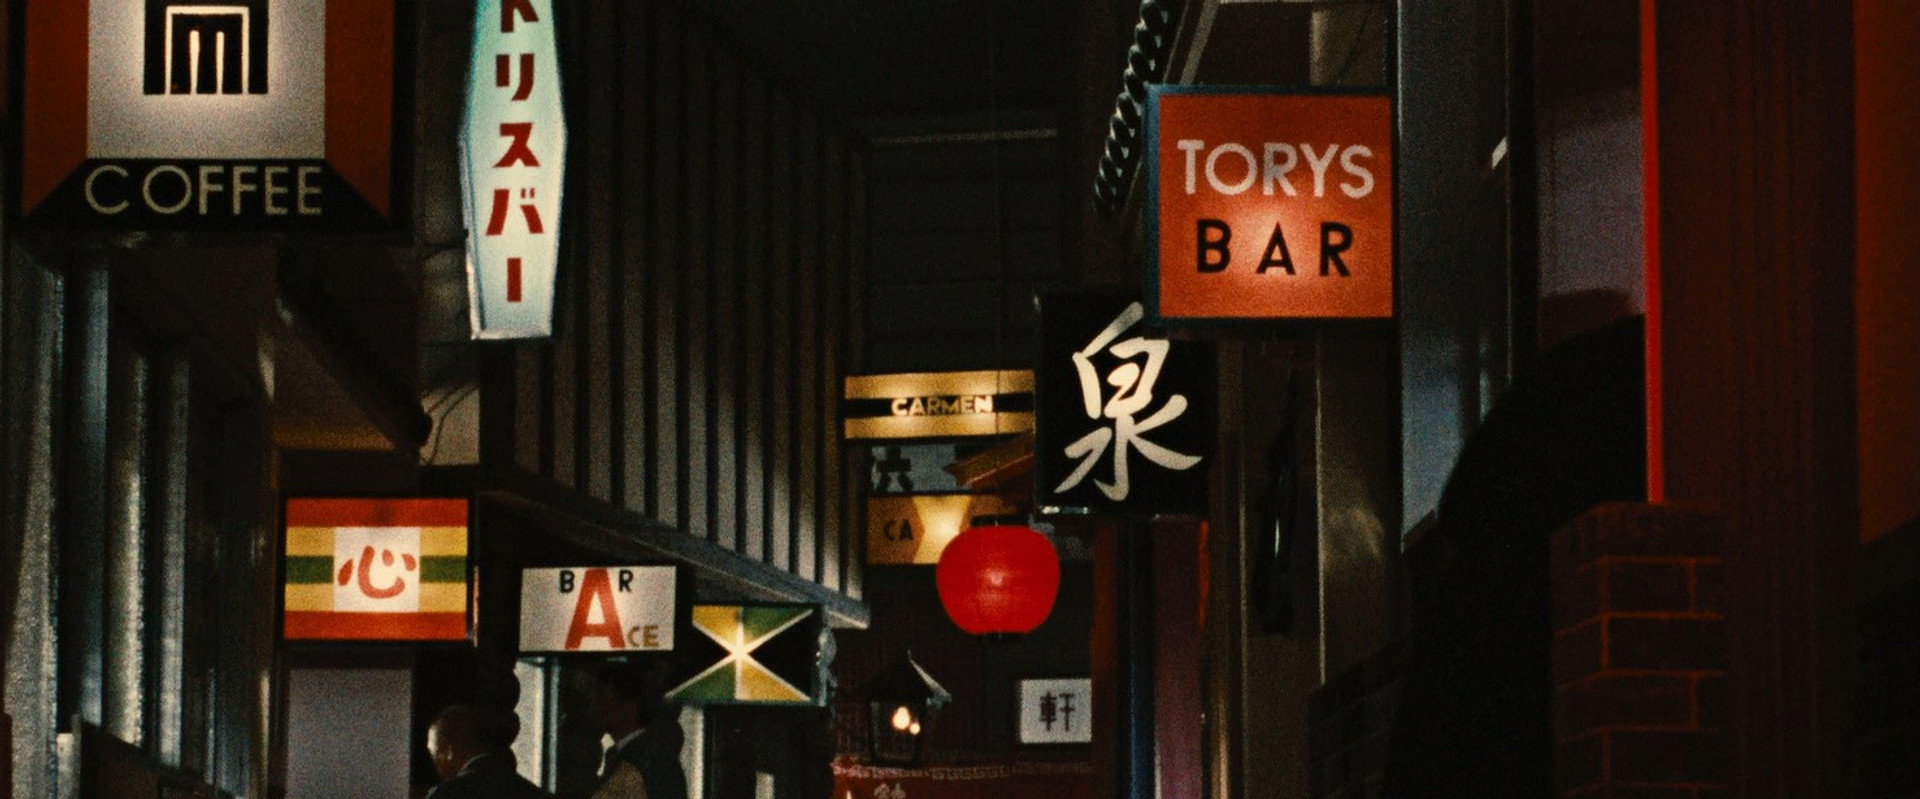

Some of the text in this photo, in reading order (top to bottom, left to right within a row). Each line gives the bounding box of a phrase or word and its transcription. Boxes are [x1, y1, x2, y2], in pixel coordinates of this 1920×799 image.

[85, 164, 322, 215] COFFEE
[1177, 138, 1375, 199] TORYS
[1197, 218, 1353, 277] BAR
[890, 394, 994, 416] CARMEN
[1053, 300, 1203, 502] 泉
[338, 545, 417, 598] 心
[1040, 692, 1076, 732] 軒
